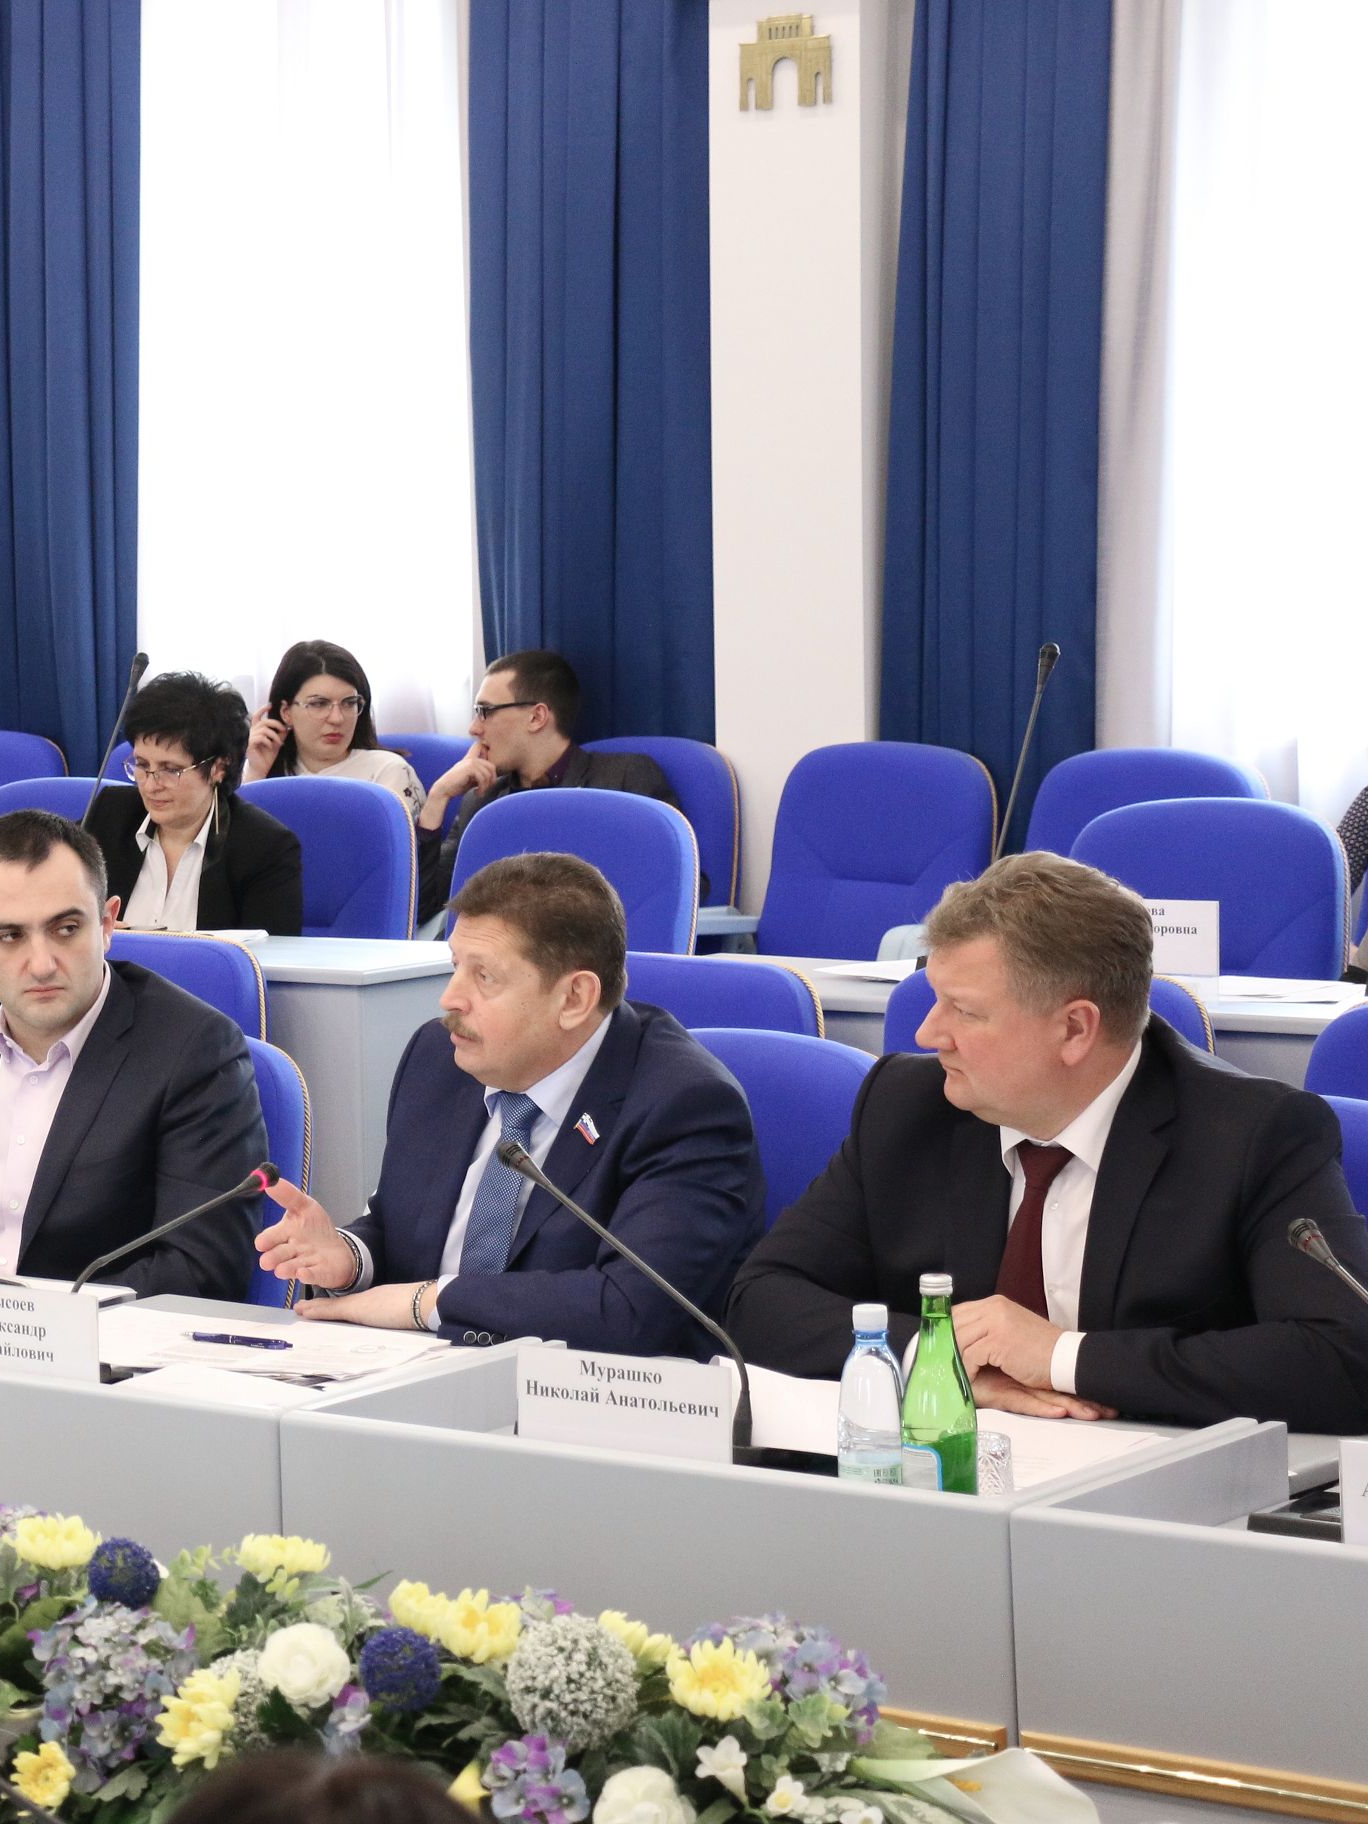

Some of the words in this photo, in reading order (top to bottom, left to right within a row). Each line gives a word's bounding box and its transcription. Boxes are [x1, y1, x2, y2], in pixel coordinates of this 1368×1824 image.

[1152, 925, 1198, 937] оровна
[579, 1359, 663, 1385] Мурашко
[525, 1379, 600, 1405] Николай
[605, 1389, 720, 1418] Анатольевич
